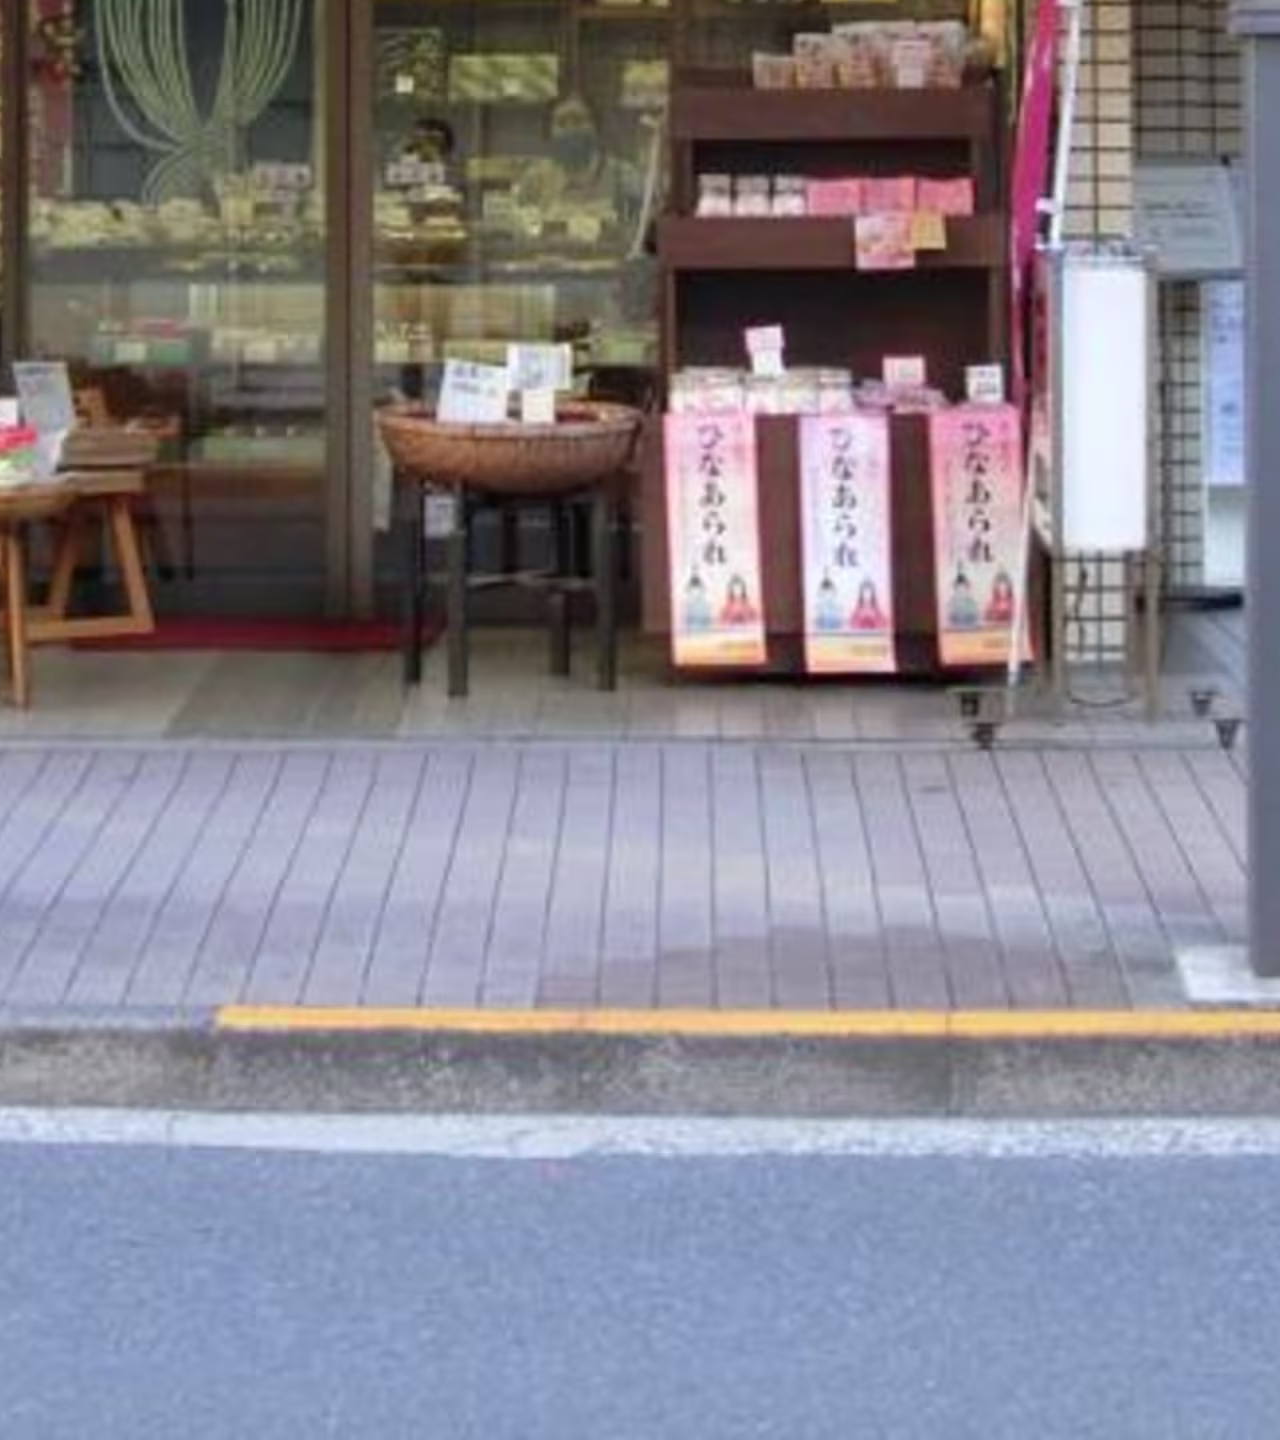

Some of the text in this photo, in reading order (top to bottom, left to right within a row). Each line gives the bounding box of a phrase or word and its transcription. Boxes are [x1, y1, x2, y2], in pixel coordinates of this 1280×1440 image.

[697, 423, 727, 566] ひなあられ
[831, 428, 859, 569] ひなあられ
[963, 422, 993, 564] ひなあられ
